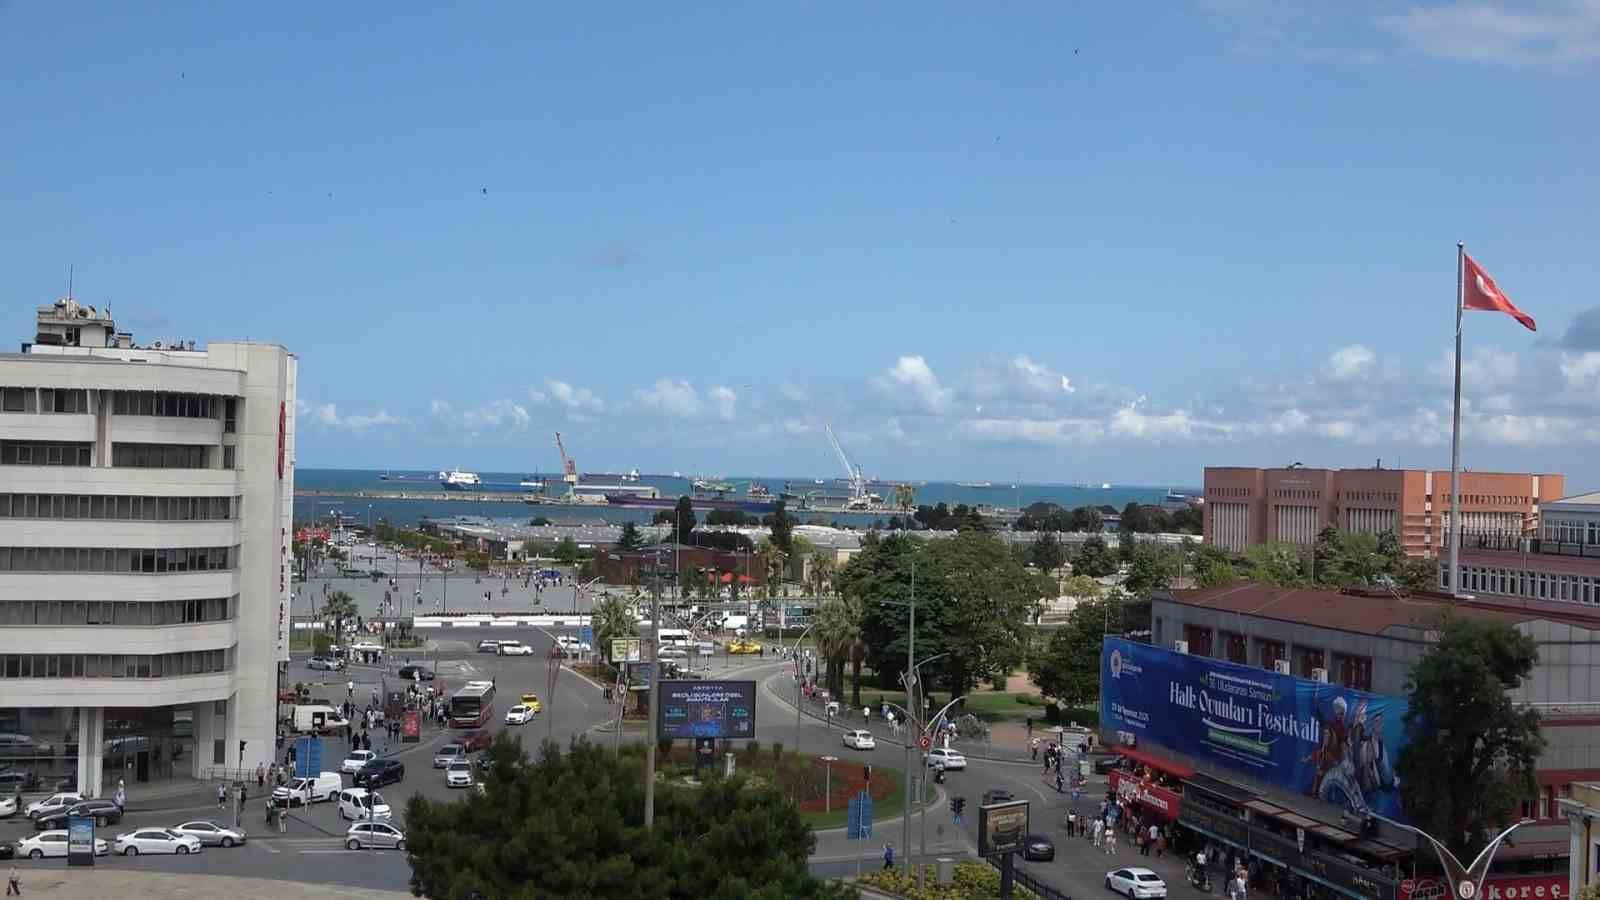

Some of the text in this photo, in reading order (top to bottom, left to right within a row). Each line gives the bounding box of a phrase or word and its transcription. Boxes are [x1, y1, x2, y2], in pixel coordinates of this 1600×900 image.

[1170, 681, 1196, 710] Halk
[1199, 689, 1253, 725] Oyunları
[1258, 703, 1320, 744] Festivali
